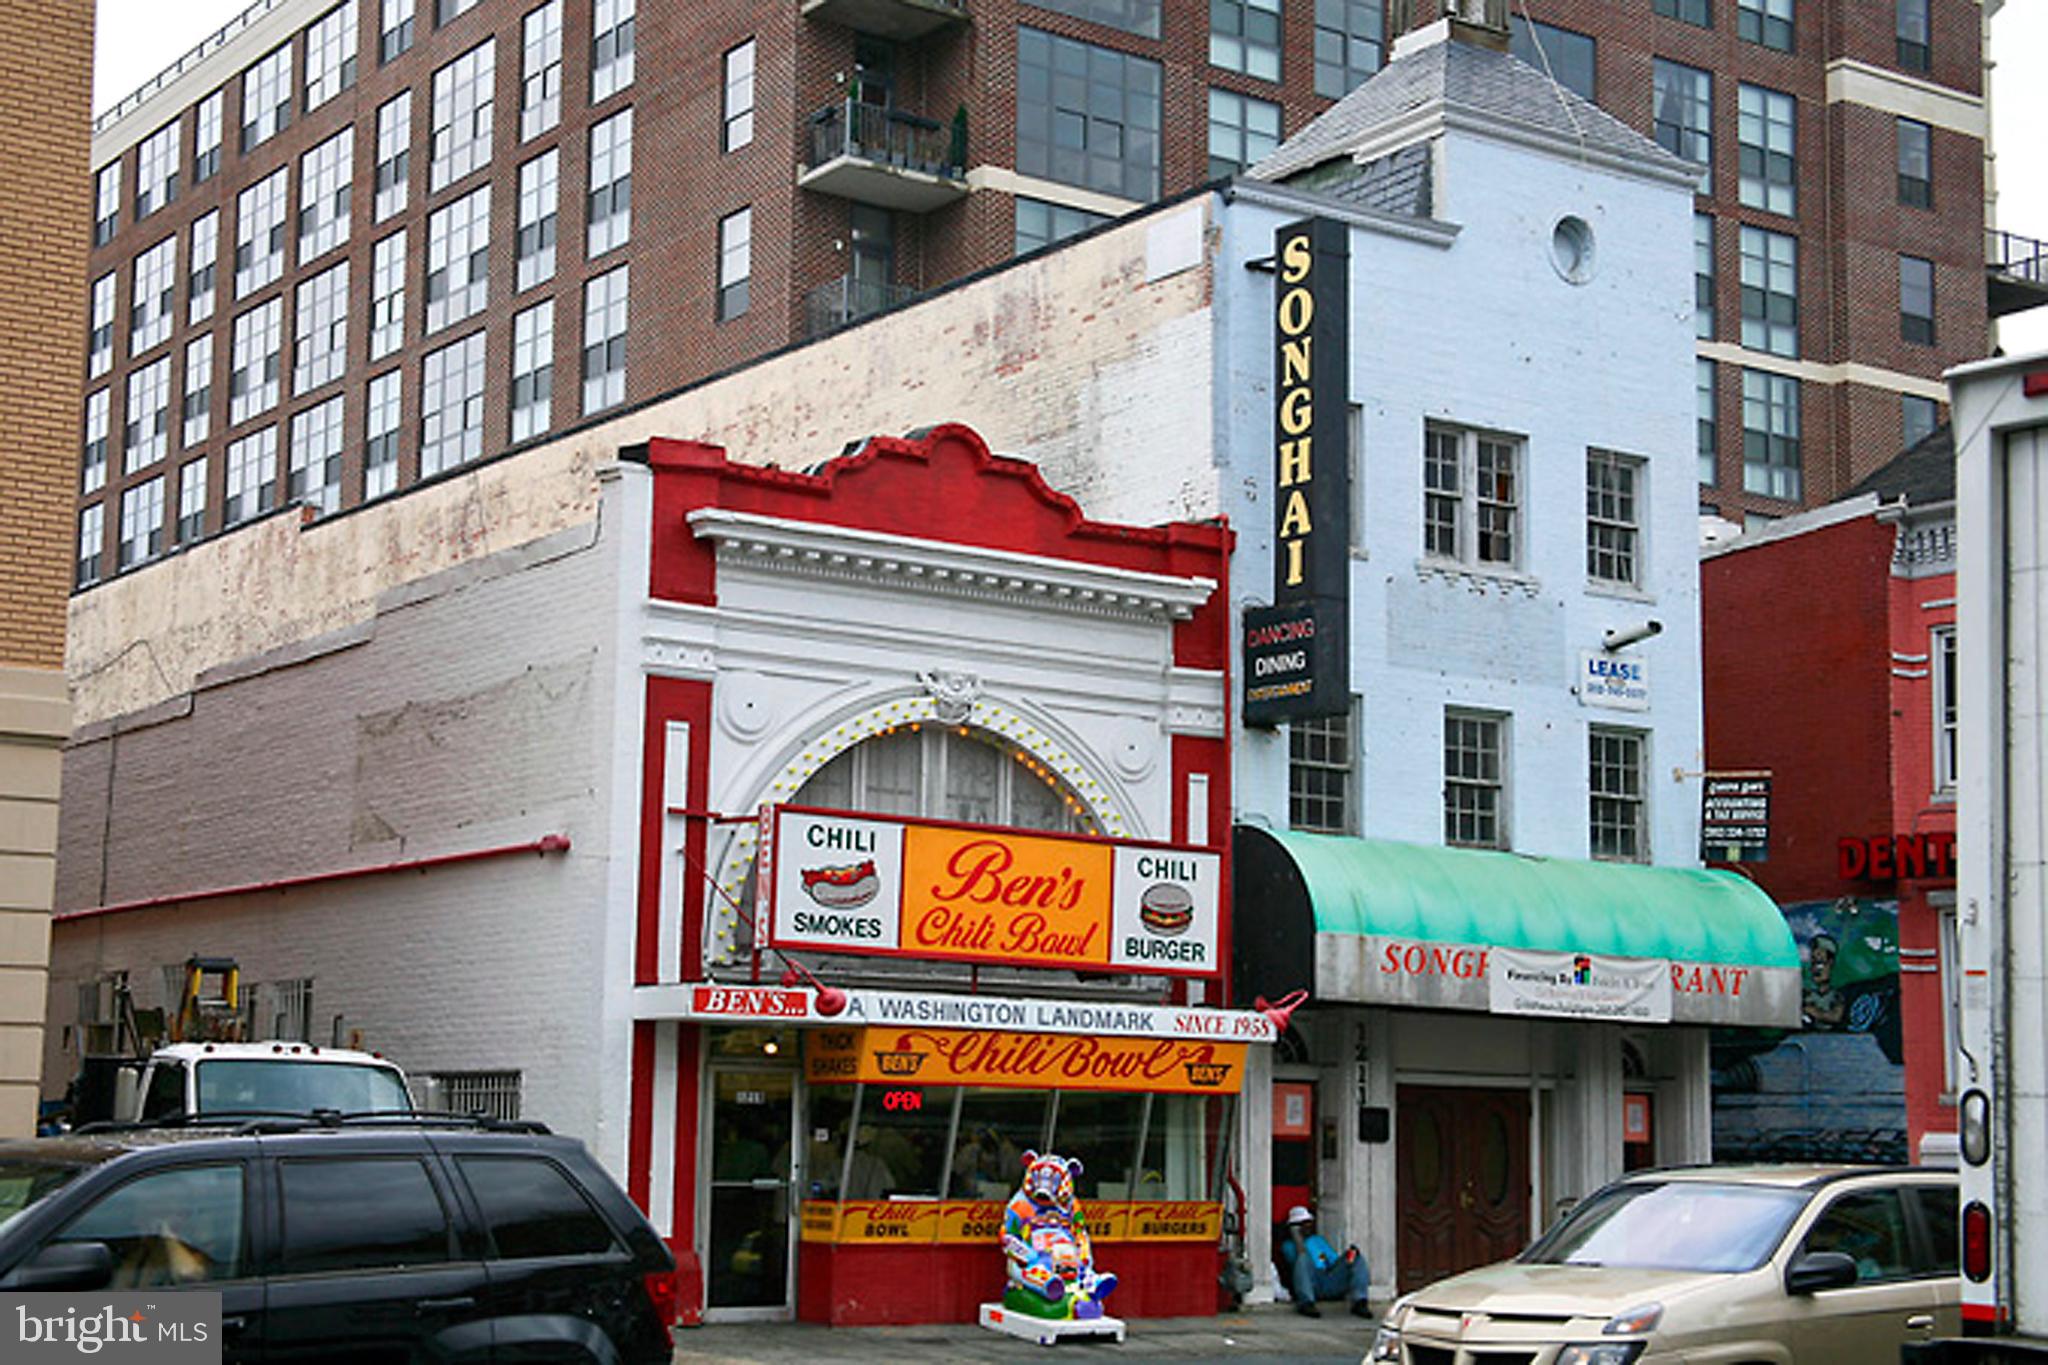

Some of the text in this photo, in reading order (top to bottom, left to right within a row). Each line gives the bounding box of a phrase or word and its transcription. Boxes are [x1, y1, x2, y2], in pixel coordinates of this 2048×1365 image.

[1278, 234, 1314, 587] SONGHAI
[1247, 618, 1315, 648] DANCING
[1255, 650, 1306, 677] DINING
[1588, 659, 1642, 681] LEASE
[807, 823, 876, 853] CHILI
[1137, 857, 1198, 882] CHILI
[1838, 833, 1957, 880] DENT
[931, 840, 1085, 910] Ben's
[793, 912, 882, 938] SMOKES
[915, 906, 1099, 956] Chili Bowl
[1125, 936, 1206, 962] BURGER
[846, 998, 865, 1016] A
[878, 999, 1026, 1024] WASHINGTON
[1037, 1008, 1154, 1031] LANDMARK
[1174, 1015, 1226, 1035] SINCE
[947, 1028, 1190, 1079] Chili Bowl
[882, 1091, 923, 1111] OPEN
[868, 1204, 918, 1221] Chili
[1155, 1203, 1198, 1220] Chili
[865, 1223, 909, 1237] BOWL
[1143, 1222, 1207, 1235] BURGERS
